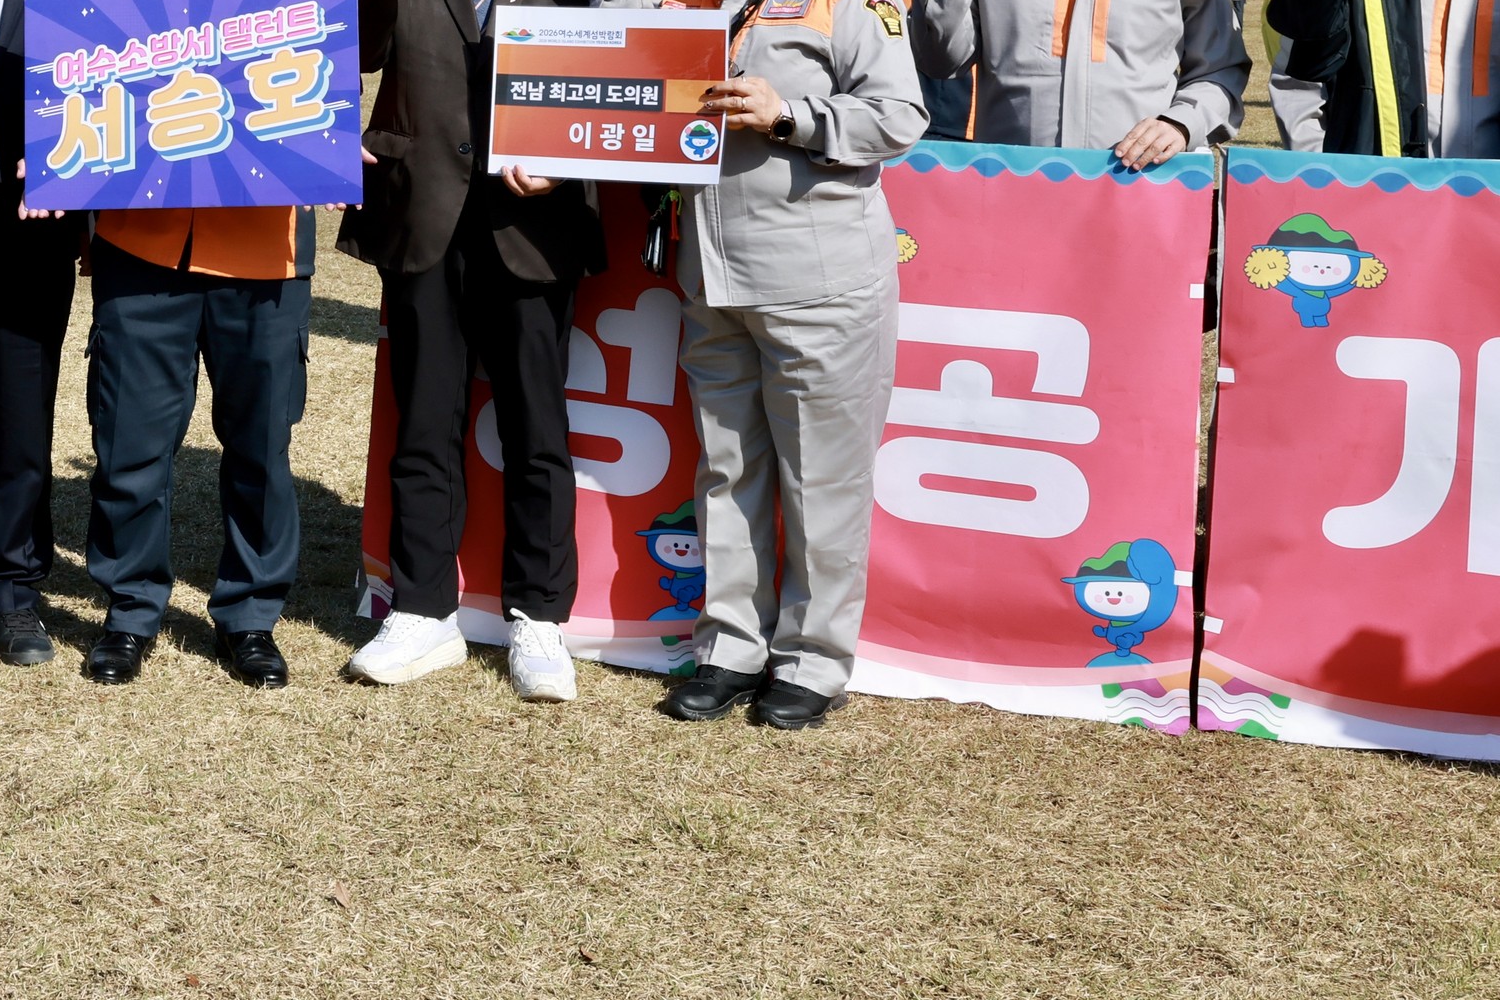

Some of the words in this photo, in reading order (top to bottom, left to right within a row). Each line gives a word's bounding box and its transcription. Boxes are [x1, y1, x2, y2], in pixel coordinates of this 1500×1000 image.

[52, 21, 220, 94] 여수소방서
[219, 0, 327, 61] 탤런트
[510, 80, 545, 100] 전남
[549, 82, 601, 103] 최고의
[605, 84, 659, 106] 도의원
[46, 46, 336, 179] 서승호
[568, 121, 656, 152] 이광일
[872, 302, 1101, 539] 공
